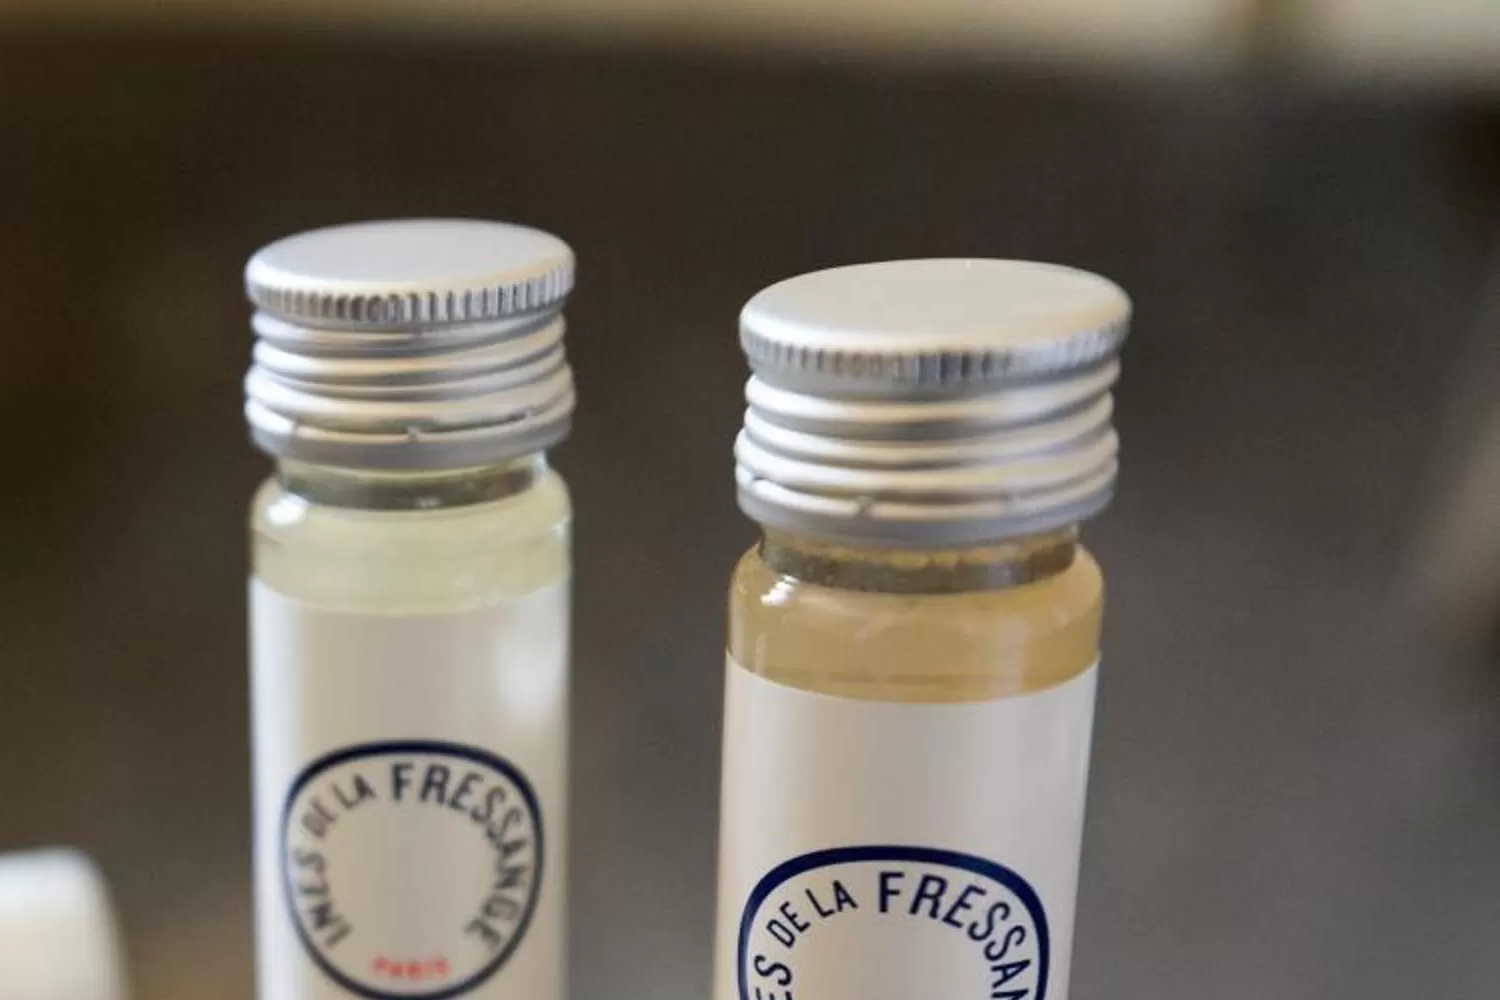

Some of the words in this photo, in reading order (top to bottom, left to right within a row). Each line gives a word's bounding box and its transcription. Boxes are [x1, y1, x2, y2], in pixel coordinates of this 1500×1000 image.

[302, 794, 337, 838] DE
[331, 772, 377, 810] LA
[390, 761, 531, 951] FRESSANGE
[293, 847, 353, 948] INES
[765, 901, 811, 949] DE
[804, 879, 859, 919] LA
